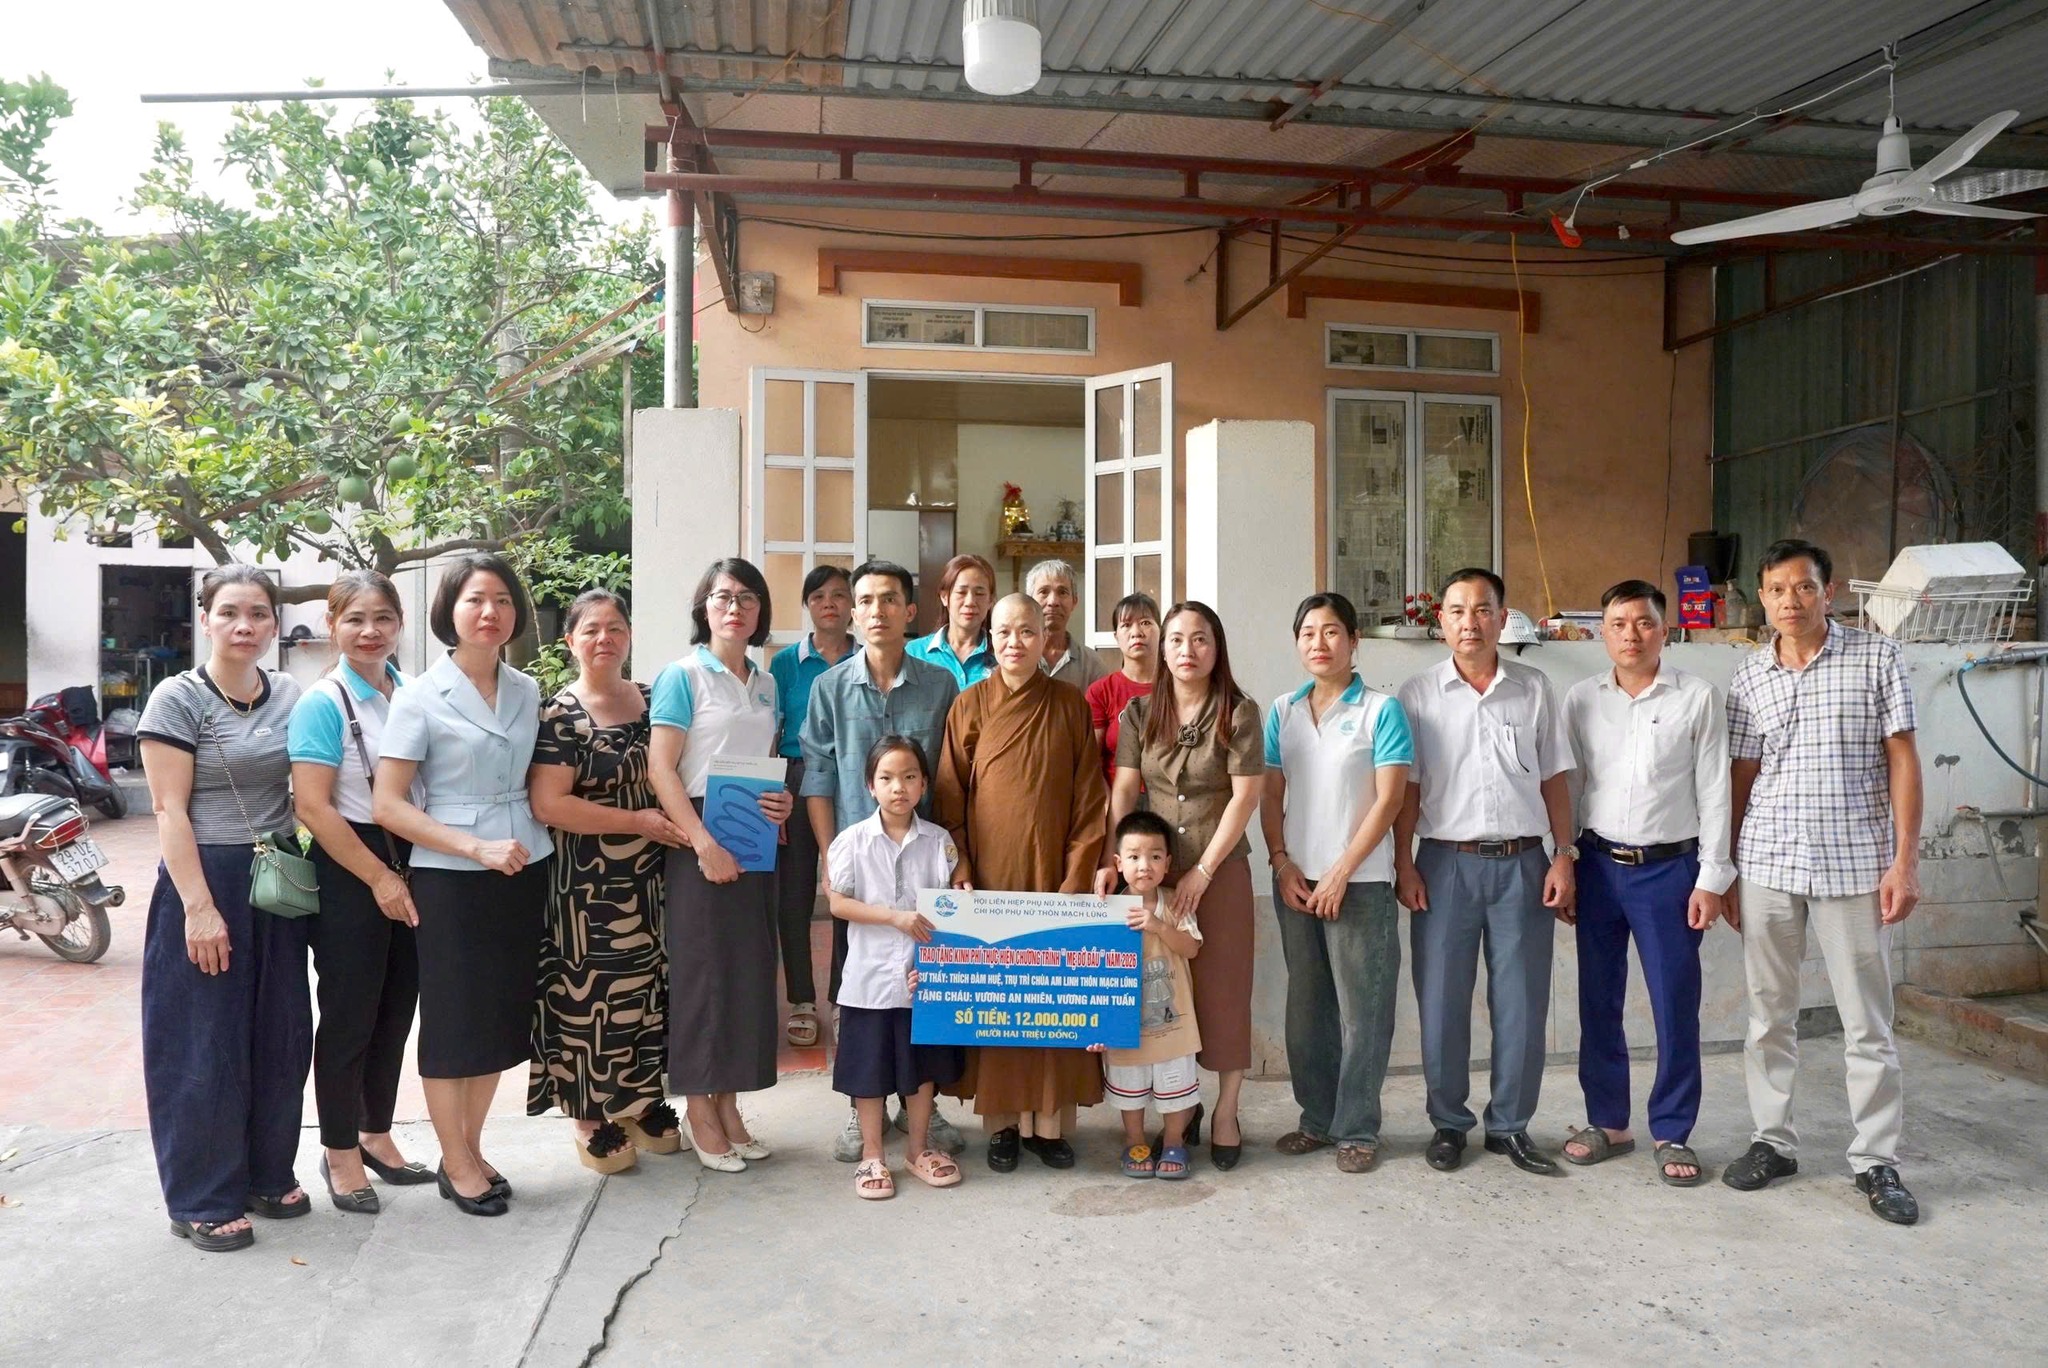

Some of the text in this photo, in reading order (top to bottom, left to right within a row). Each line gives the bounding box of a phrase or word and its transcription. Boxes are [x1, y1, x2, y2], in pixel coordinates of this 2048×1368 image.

[67, 853, 99, 876] 3707
[989, 897, 1005, 905] LIÊN
[1038, 909, 1059, 917] THÔN
[919, 947, 935, 963] TRAO
[936, 944, 953, 967] TẶNG
[954, 947, 970, 964] KINH
[970, 945, 982, 964] PHÍ
[983, 947, 998, 968] THỰC
[999, 946, 1015, 968] HIỆN
[1016, 948, 1040, 966] CHƯƠNG
[1041, 947, 1060, 967] TRÌNH
[1105, 949, 1121, 968] NĂM
[918, 971, 928, 982] SƯ
[950, 970, 969, 983] THÍCH
[970, 972, 986, 984] ĐÀM
[987, 972, 1003, 987] HUỆ,
[1004, 974, 1017, 987] TRỤ
[1019, 973, 1030, 985] TRÌ
[1051, 975, 1062, 986] AM
[1063, 976, 1079, 986] LINH
[1080, 975, 1098, 987] THÔN
[1099, 976, 1119, 989] MẠCH
[918, 989, 1135, 1006] TẶNG CHÁU: VƯƠNG AN NHIÊN, VƯƠNG ANH TUẤN
[954, 1006, 974, 1024] SỐ
[977, 1006, 1010, 1025] TIỀN:
[1015, 1011, 1086, 1027] 12.000.000
[975, 1028, 1001, 1039] (MƯỜI
[1003, 1030, 1018, 1038] HAI
[1021, 1029, 1046, 1040] TRIỆU
